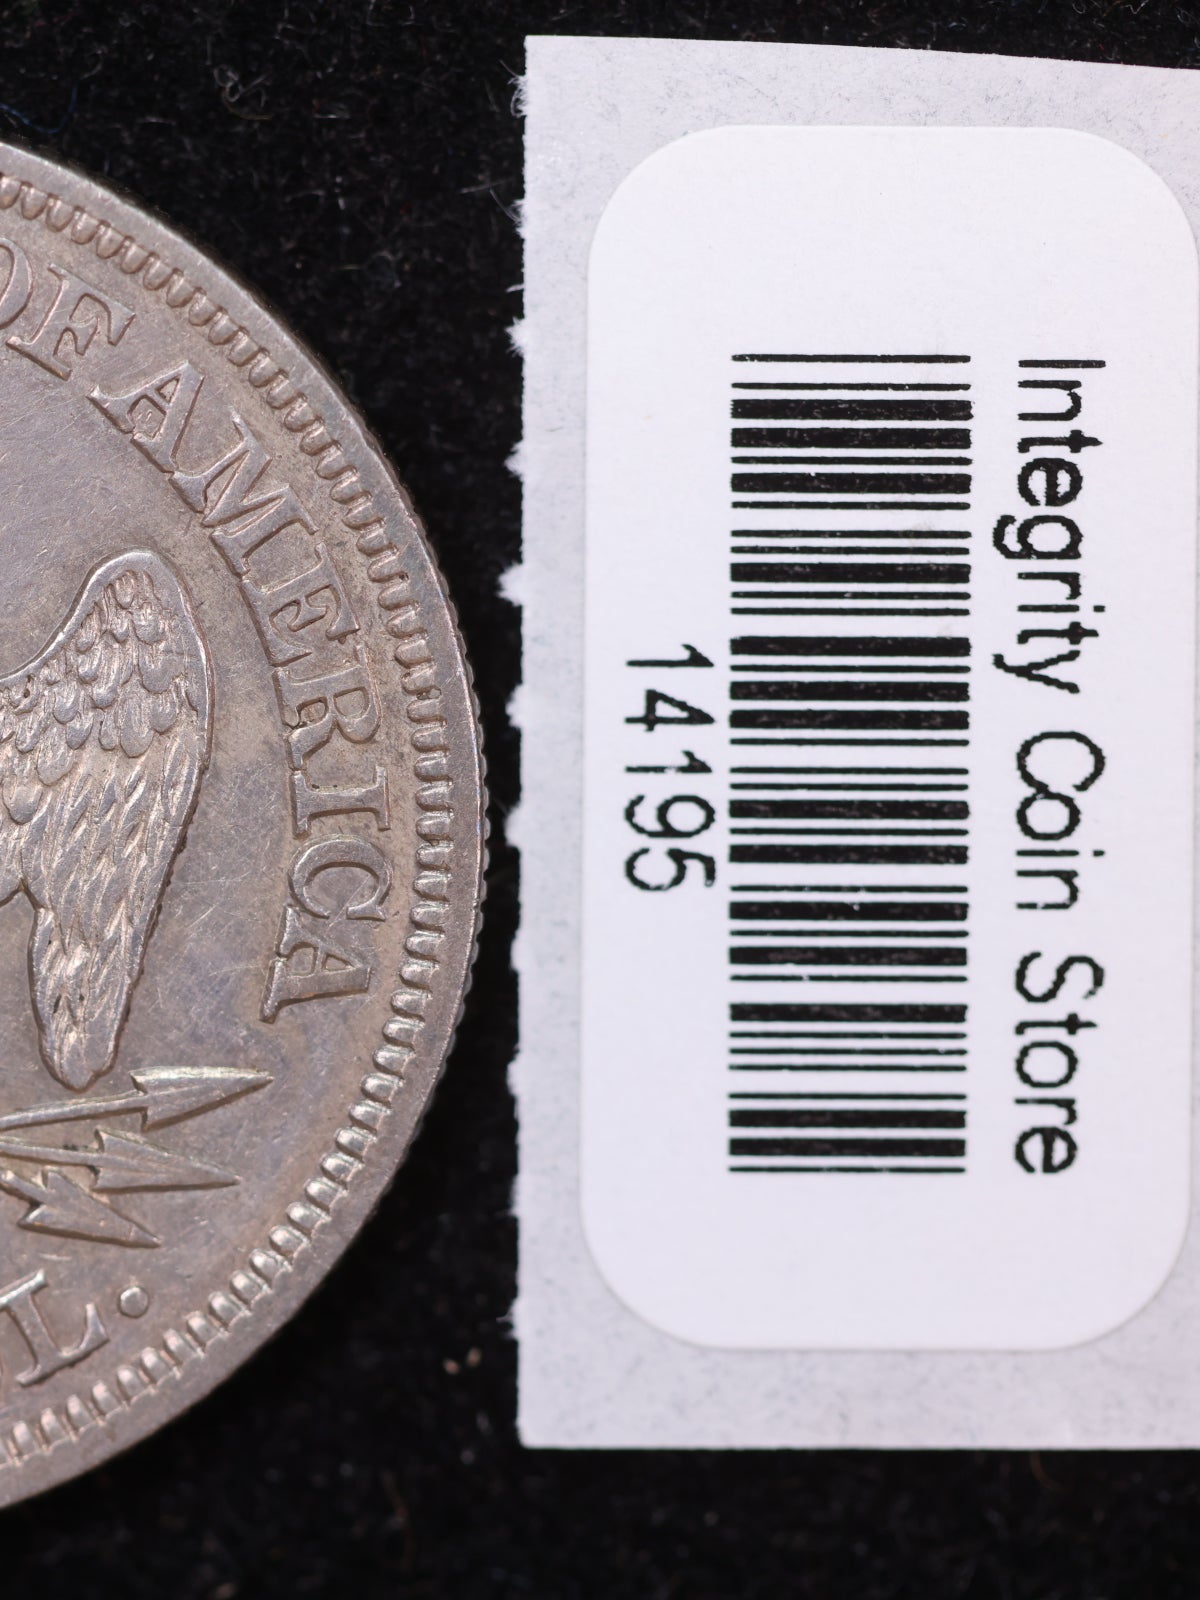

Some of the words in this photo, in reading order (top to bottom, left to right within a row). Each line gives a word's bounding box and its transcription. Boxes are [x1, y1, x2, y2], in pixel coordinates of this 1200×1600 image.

[992, 359, 1107, 694] Integrity
[86, 360, 394, 1023] AMERICA
[624, 643, 718, 893] 14195
[1014, 730, 1106, 911] Coin
[1013, 951, 1105, 1176] Store
